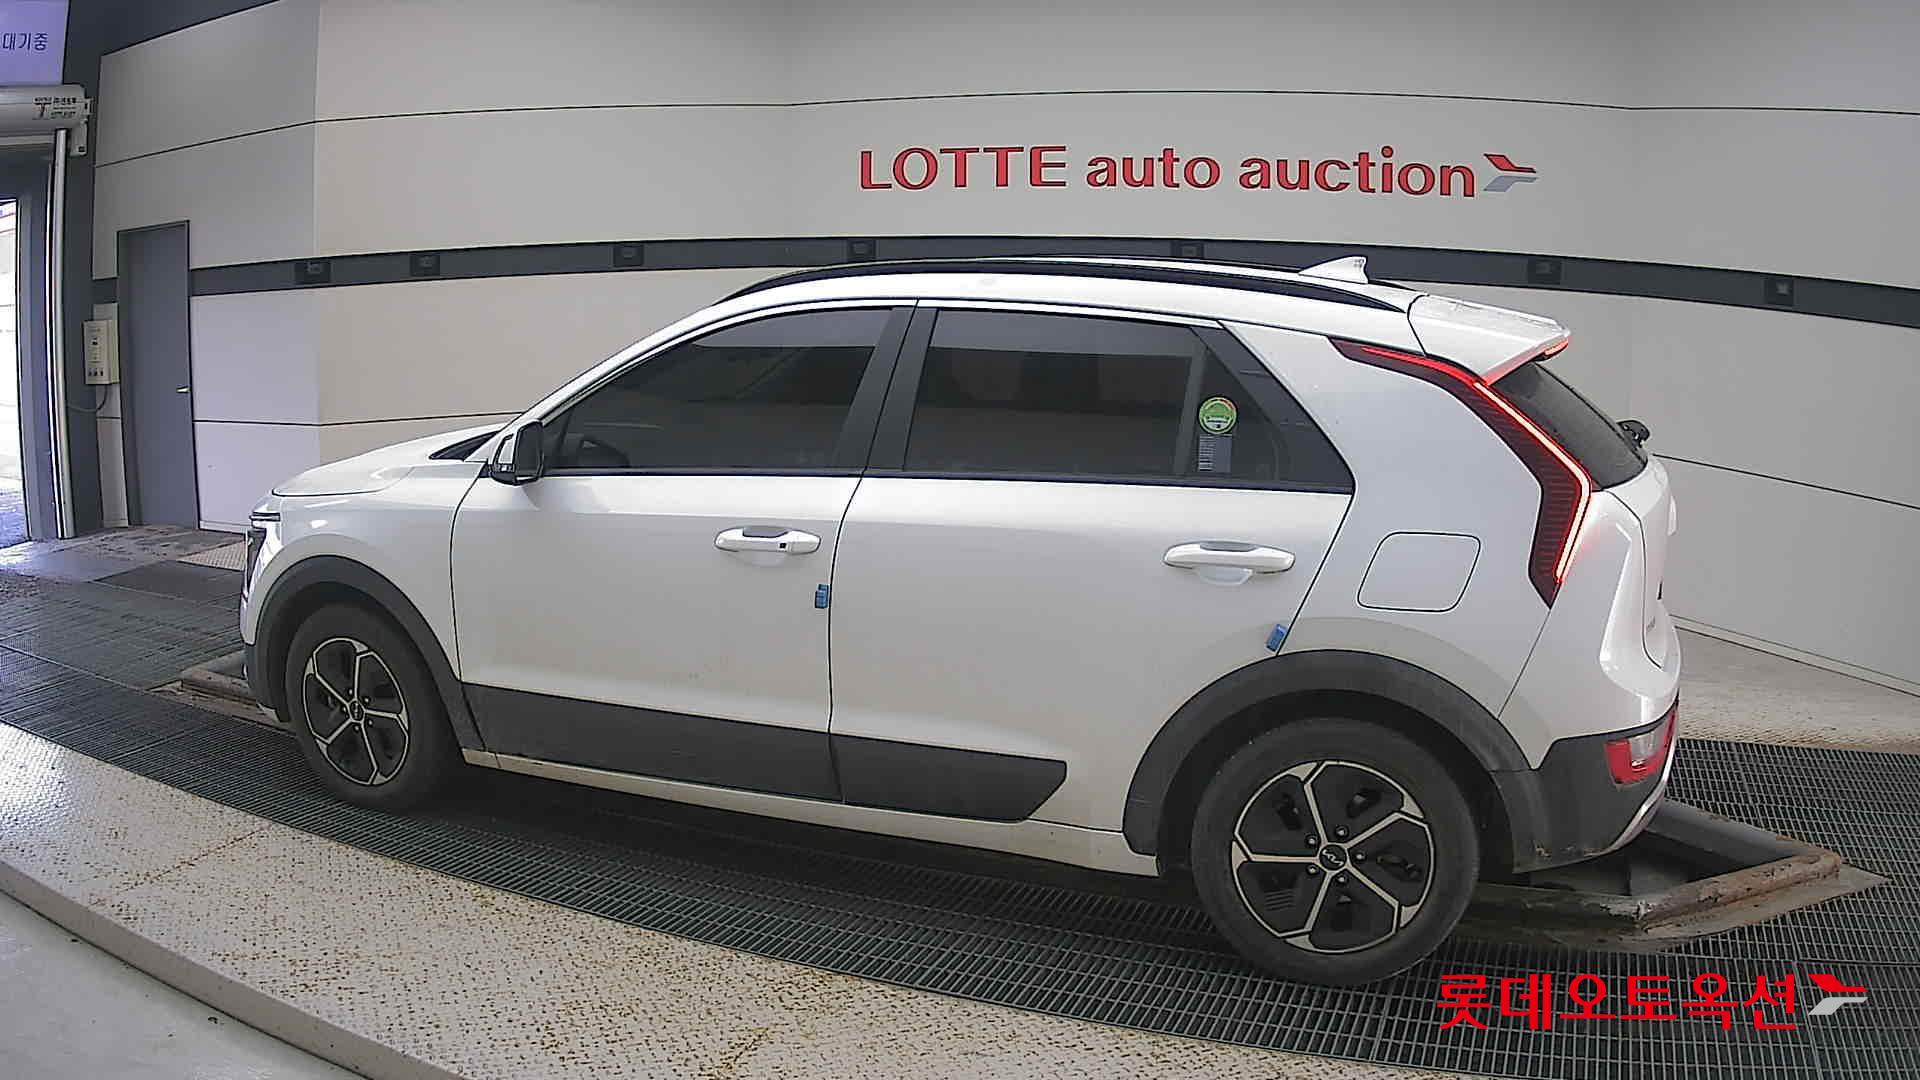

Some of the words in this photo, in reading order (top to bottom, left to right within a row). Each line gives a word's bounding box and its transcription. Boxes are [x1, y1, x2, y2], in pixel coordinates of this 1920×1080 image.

[2, 32, 49, 51] 대기중
[859, 145, 1068, 190] LOTTE
[1086, 148, 1222, 190] auto
[1238, 145, 1477, 197] auction
